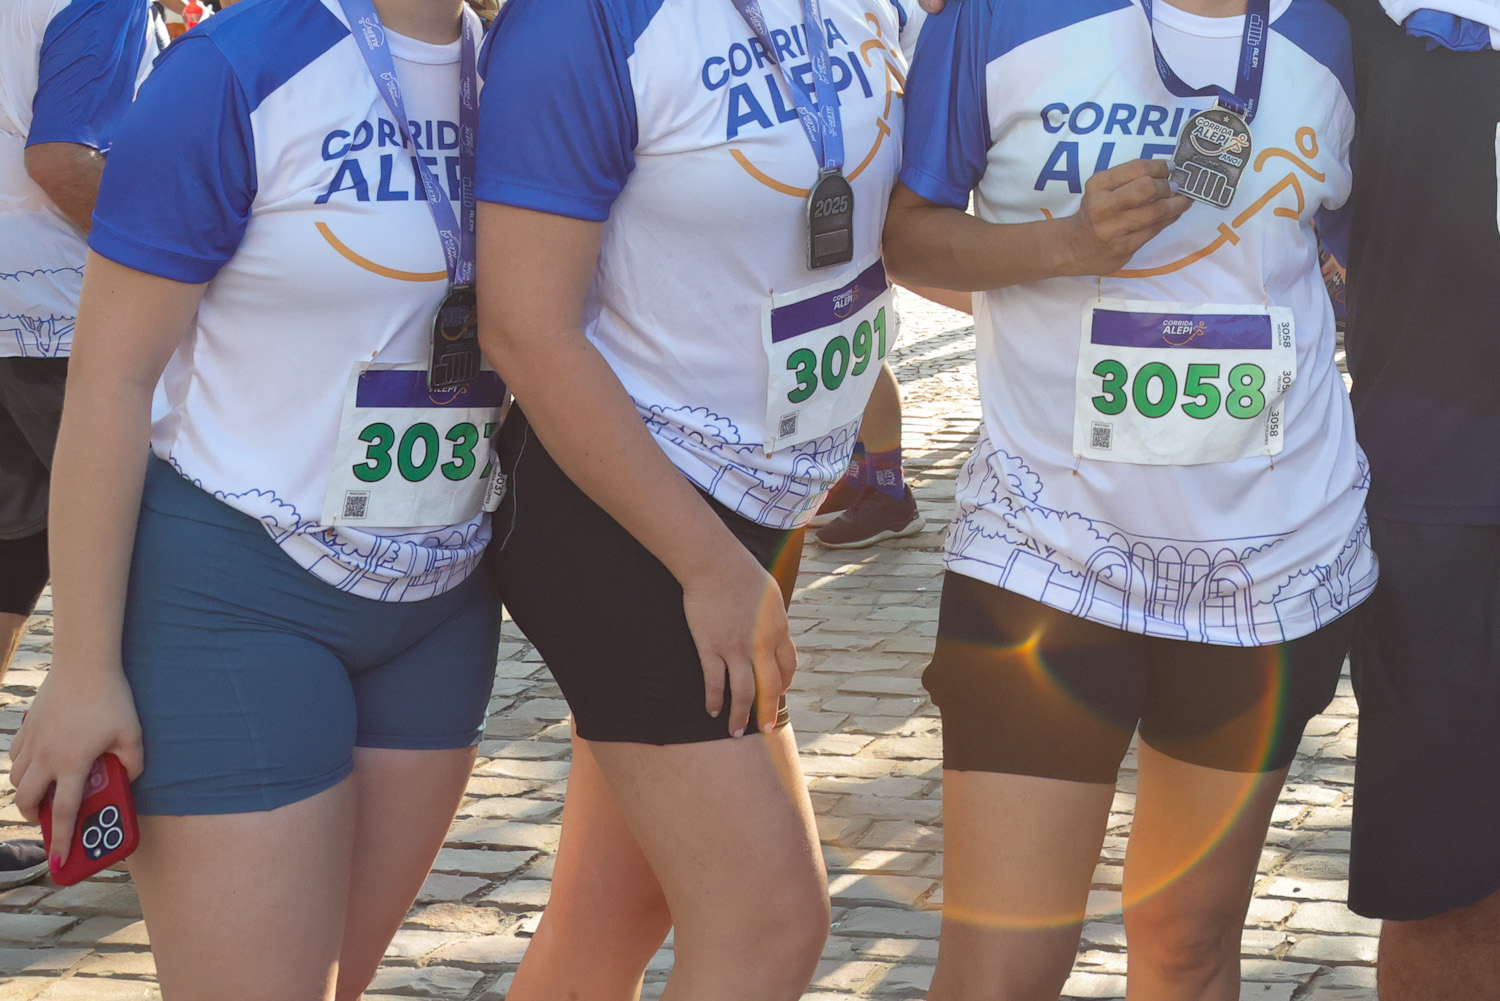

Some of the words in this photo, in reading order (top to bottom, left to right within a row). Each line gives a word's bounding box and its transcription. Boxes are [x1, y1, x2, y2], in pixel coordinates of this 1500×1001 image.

[701, 17, 849, 92] CORRIA
[321, 117, 460, 162] CORRID
[1193, 126, 1230, 146] ALEPI
[1196, 117, 1233, 137] CORRIDA
[814, 195, 849, 219] 2025
[1162, 319, 1193, 327] CORRIDA
[1162, 326, 1193, 335] ALEPI
[1281, 321, 1291, 348] 3058
[787, 306, 886, 404] 3091
[1091, 358, 1266, 420] 3058
[1282, 370, 1292, 396] 305
[1269, 410, 1280, 437] 3058
